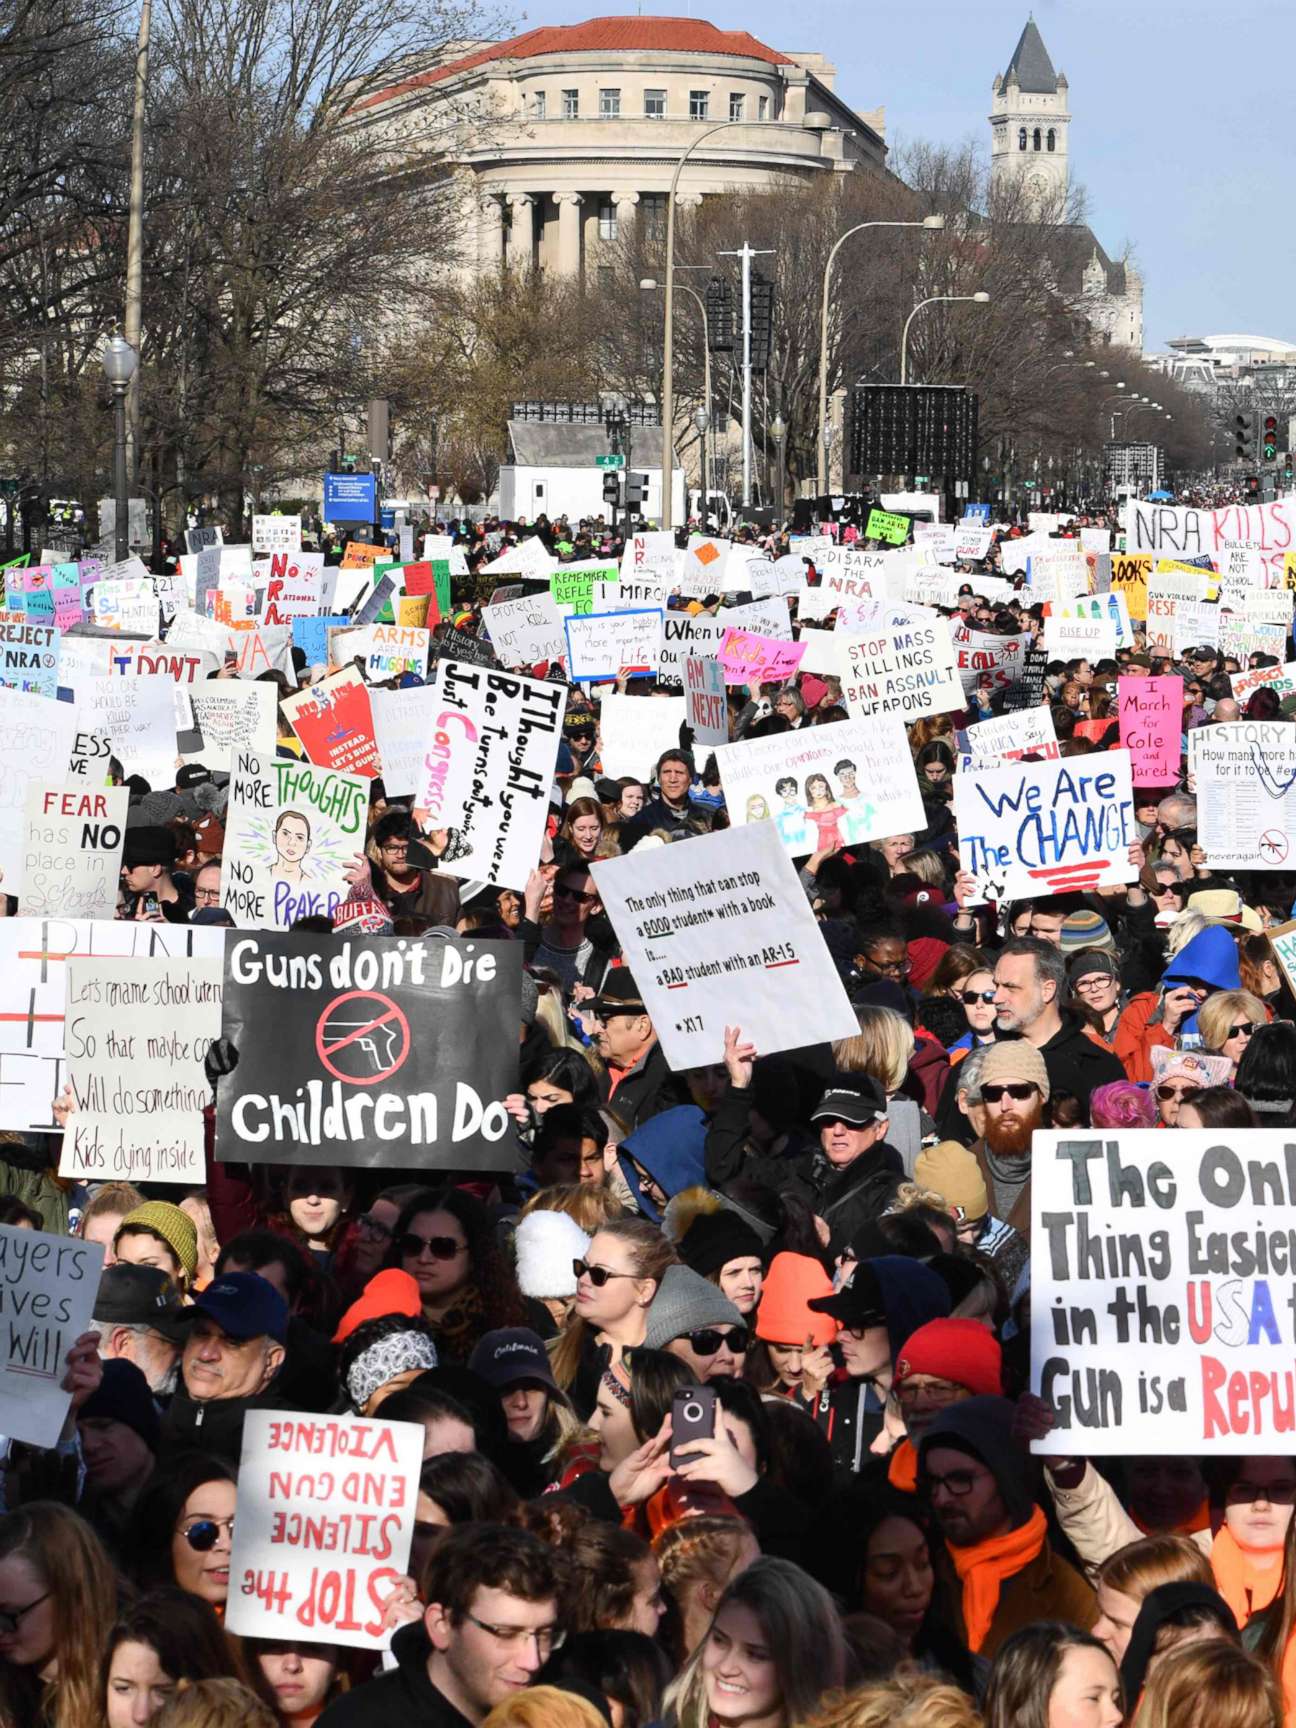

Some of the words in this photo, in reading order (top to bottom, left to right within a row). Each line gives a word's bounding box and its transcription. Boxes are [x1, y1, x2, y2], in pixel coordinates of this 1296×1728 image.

[1136, 508, 1201, 552] NRA
[1212, 503, 1292, 552] KILLS
[554, 571, 609, 585] REMEMBER
[1228, 563, 1247, 573] NOT
[1230, 551, 1249, 562] ARE
[372, 627, 427, 647] ARMS
[664, 619, 712, 641] When
[848, 639, 888, 661] STOP
[893, 629, 936, 651] MASS
[5, 650, 41, 669] NRA
[370, 654, 423, 674] HUGGING
[852, 650, 934, 679] KILLINGS
[847, 682, 880, 702] BAN
[886, 666, 954, 695] ASSAULT
[1124, 695, 1171, 712] March
[424, 710, 479, 812] Congress
[1126, 732, 1166, 749] Cole
[237, 753, 260, 776] NO
[43, 792, 108, 819] FEAR
[270, 761, 367, 835] THOUGHTS
[499, 790, 515, 833] you
[975, 774, 1042, 819] We
[1052, 767, 1117, 806] Are
[960, 833, 1014, 873] The
[1016, 801, 1132, 868] CHANGE
[487, 836, 507, 883] were
[224, 889, 265, 921] MORE
[625, 896, 645, 913] The
[645, 891, 667, 909] only
[667, 886, 696, 903] thing
[694, 879, 718, 898] that
[718, 878, 738, 890] can
[738, 870, 762, 888] stop
[231, 938, 322, 992] Guns
[329, 937, 429, 991] don't
[440, 940, 497, 988] Die
[655, 974, 664, 986] a
[662, 966, 685, 985] BAD
[685, 960, 722, 980] student
[722, 953, 747, 972] with
[748, 953, 762, 966] an
[762, 941, 796, 964] AR-15
[69, 966, 101, 1004] Let's
[105, 981, 150, 1007] rename
[153, 971, 192, 1006] school
[70, 1016, 96, 1059] So
[106, 1029, 136, 1060] that
[147, 1030, 189, 1067] maybe
[70, 1073, 107, 1113] Will
[113, 1075, 133, 1115] do
[135, 1081, 206, 1114] something
[231, 1079, 439, 1145] Children
[452, 1083, 508, 1143] Do
[72, 1125, 105, 1169] Kids
[113, 1127, 152, 1180] dying
[156, 1139, 197, 1171] inside
[1055, 1139, 1178, 1209] The
[1041, 1210, 1173, 1281] Thing
[1050, 1296, 1098, 1346] in
[1107, 1285, 1180, 1345] the
[1186, 1279, 1283, 1347] USA
[8, 1319, 62, 1376] Will
[1040, 1356, 1123, 1430] Gun
[1138, 1370, 1165, 1414] is
[1167, 1376, 1188, 1412] a
[267, 1421, 399, 1464] VIOLENCE
[270, 1511, 403, 1561] SILENCE
[241, 1568, 293, 1615] the
[296, 1567, 404, 1638] STOP
